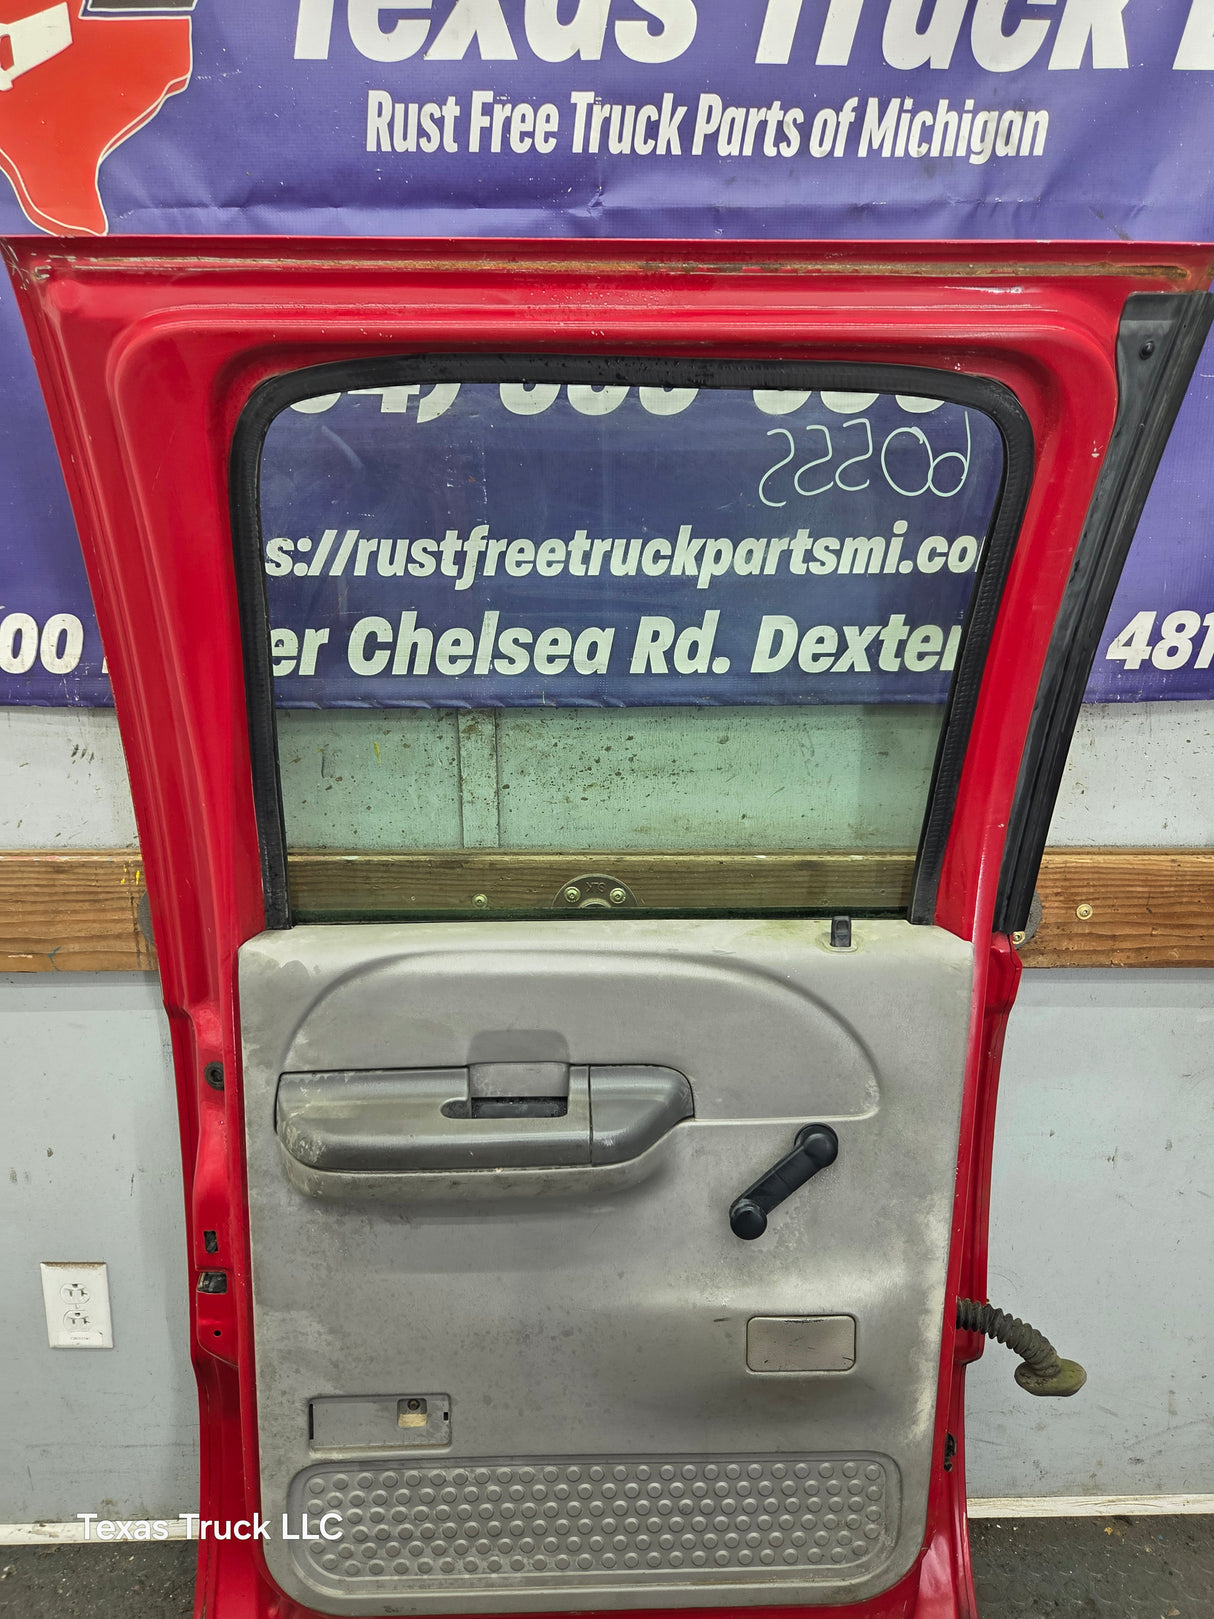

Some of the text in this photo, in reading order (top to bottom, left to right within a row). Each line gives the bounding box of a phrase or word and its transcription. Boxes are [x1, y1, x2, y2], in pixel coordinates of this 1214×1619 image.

[366, 89, 1050, 165] Rust Free Truck Parts of Michigan
[264, 519, 985, 591] s://rustfreetruckpartsmi.co
[347, 610, 615, 676] Chelsea
[629, 609, 731, 675] Rd.
